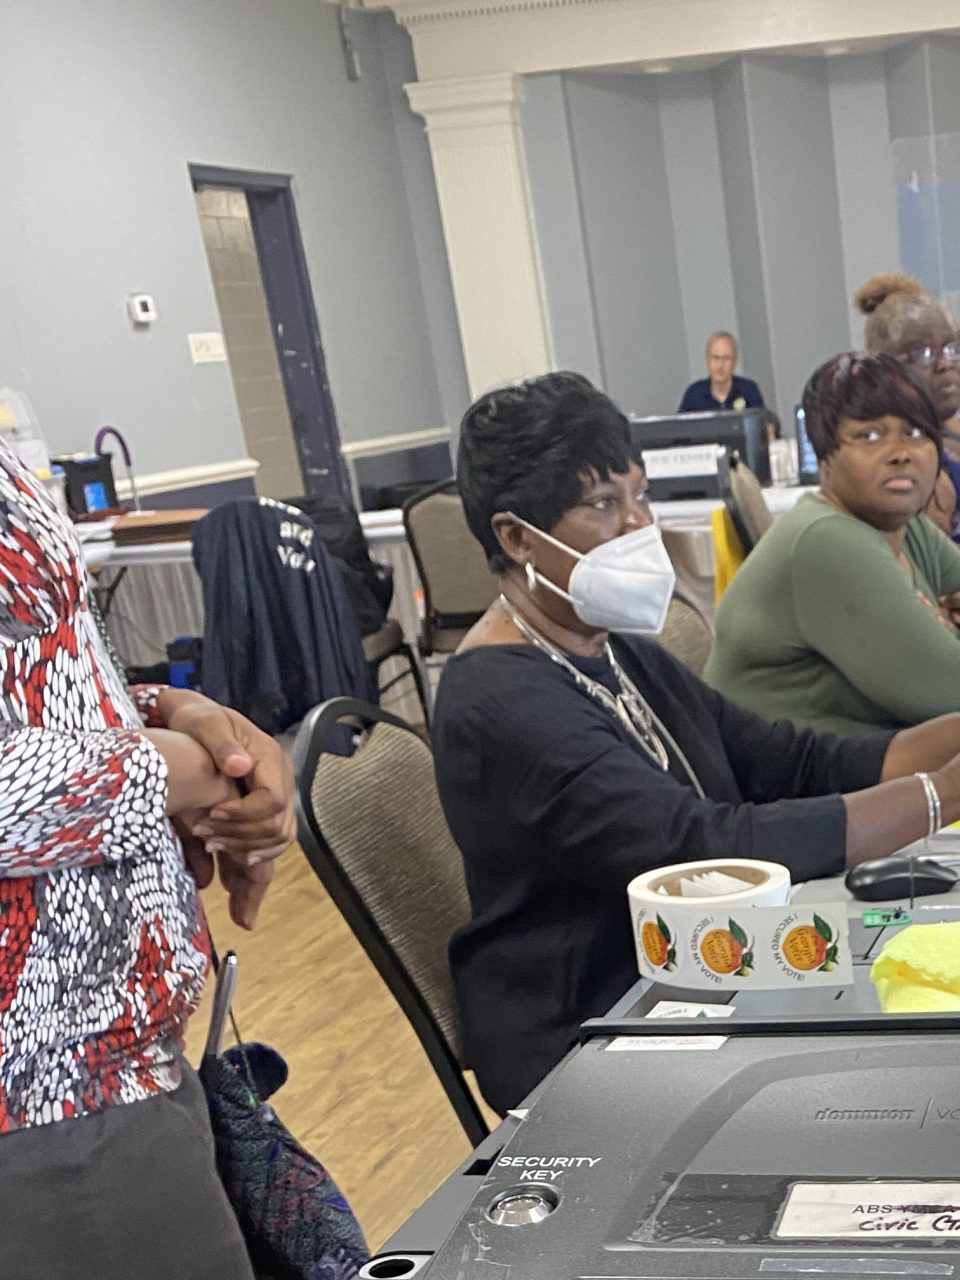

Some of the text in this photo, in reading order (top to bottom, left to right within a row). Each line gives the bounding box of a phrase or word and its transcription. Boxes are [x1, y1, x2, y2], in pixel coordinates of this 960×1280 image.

[497, 1156, 602, 1168] SECURITY
[519, 1170, 564, 1180] KEY
[852, 1204, 893, 1214] ABS
